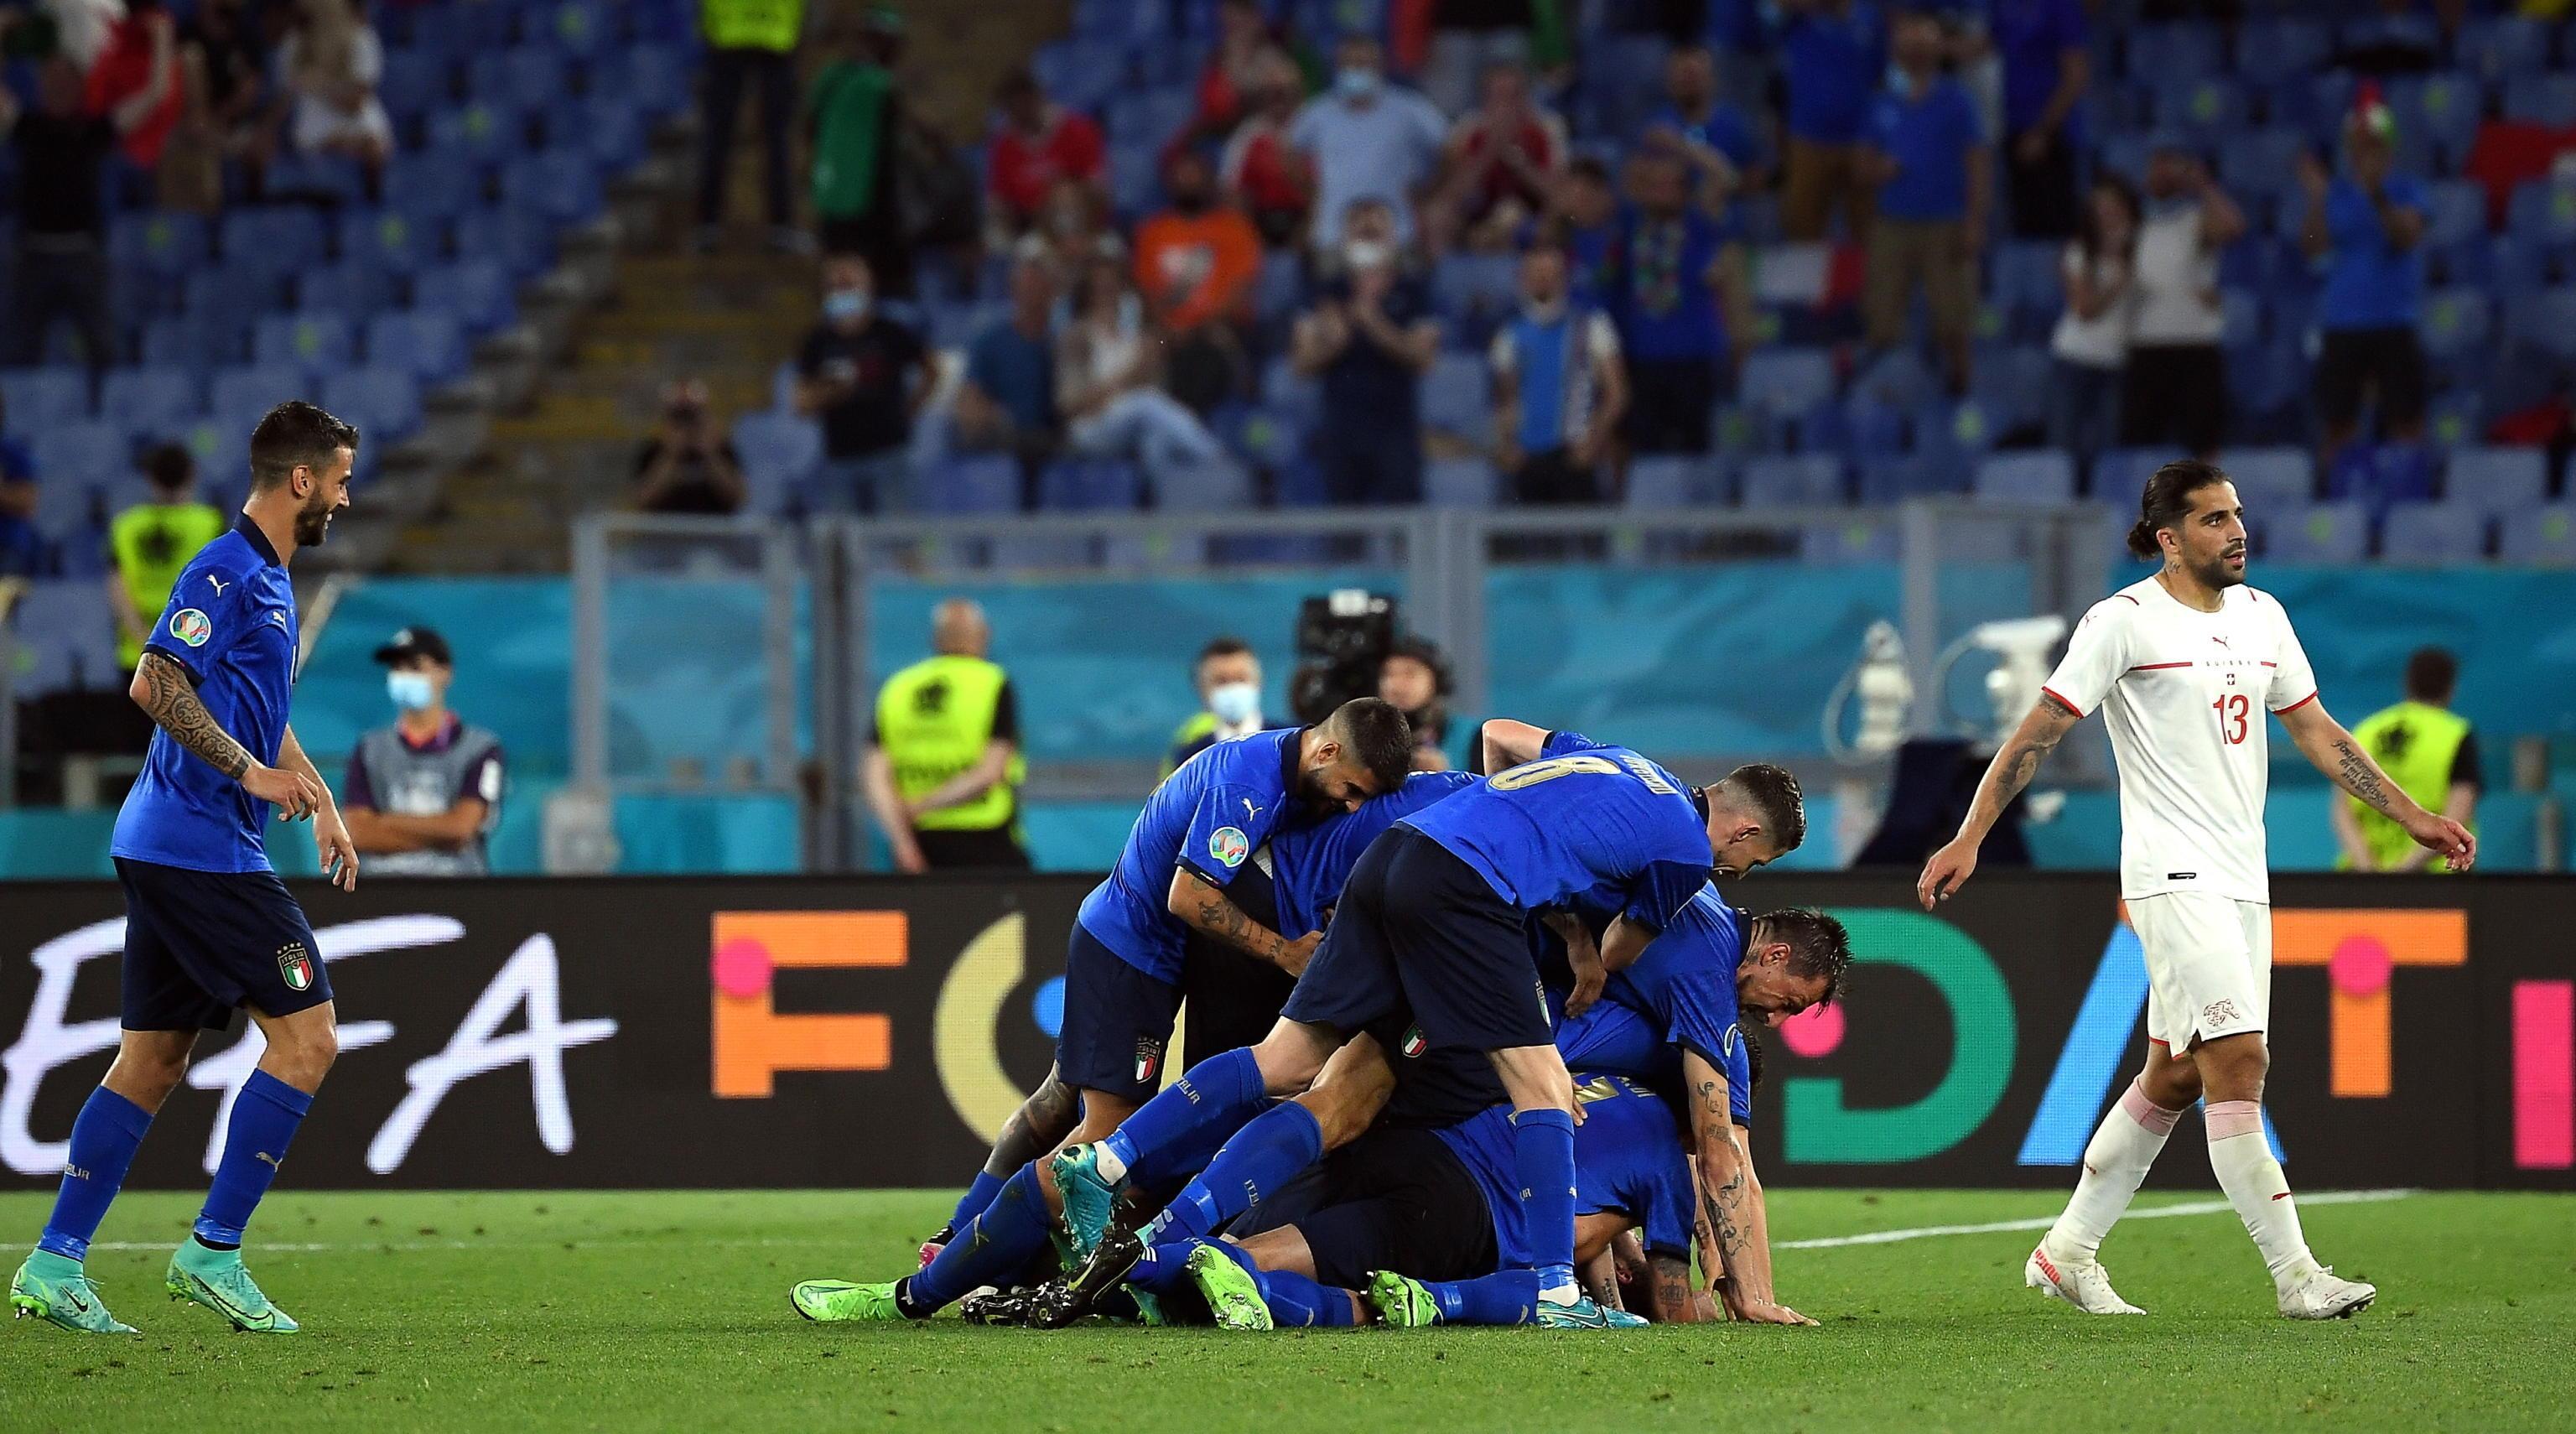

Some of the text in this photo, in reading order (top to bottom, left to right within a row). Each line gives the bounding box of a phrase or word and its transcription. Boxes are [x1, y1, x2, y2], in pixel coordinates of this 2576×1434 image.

[2213, 694, 2249, 745] 13
[0, 911, 621, 1175] EFA
[1176, 1077, 1201, 1105] TALIA
